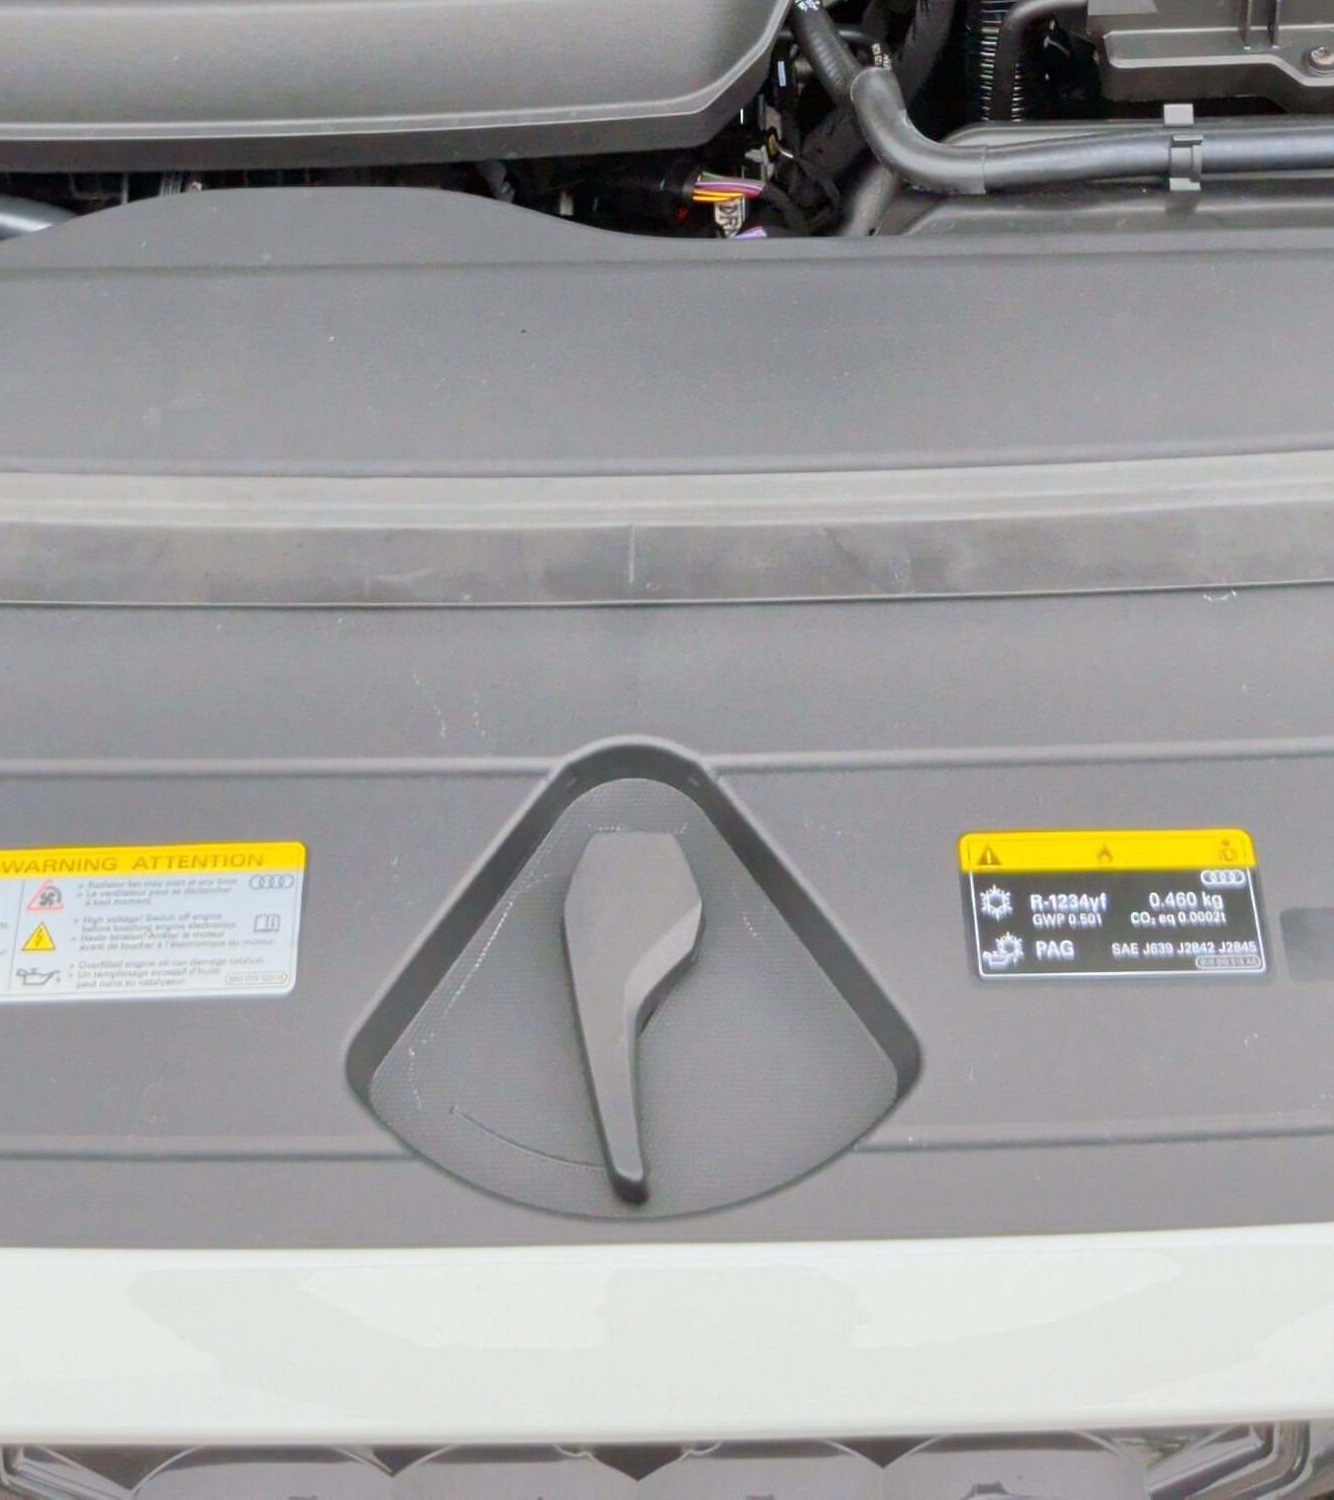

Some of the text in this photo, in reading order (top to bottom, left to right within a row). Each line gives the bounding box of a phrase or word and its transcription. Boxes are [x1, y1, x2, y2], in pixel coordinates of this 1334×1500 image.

[2, 853, 265, 874] WARNING ATTENTION
[1030, 891, 1224, 911] R-1234yf 0.460 kg
[1033, 913, 1065, 926] GWP
[1068, 913, 1102, 926] 0.501
[1159, 914, 1176, 926] eq
[1178, 912, 1227, 924] 0.0002t
[1035, 940, 1256, 958] PAG SAE J639 J2842 J2845
[93, 970, 148, 978] remplissage
